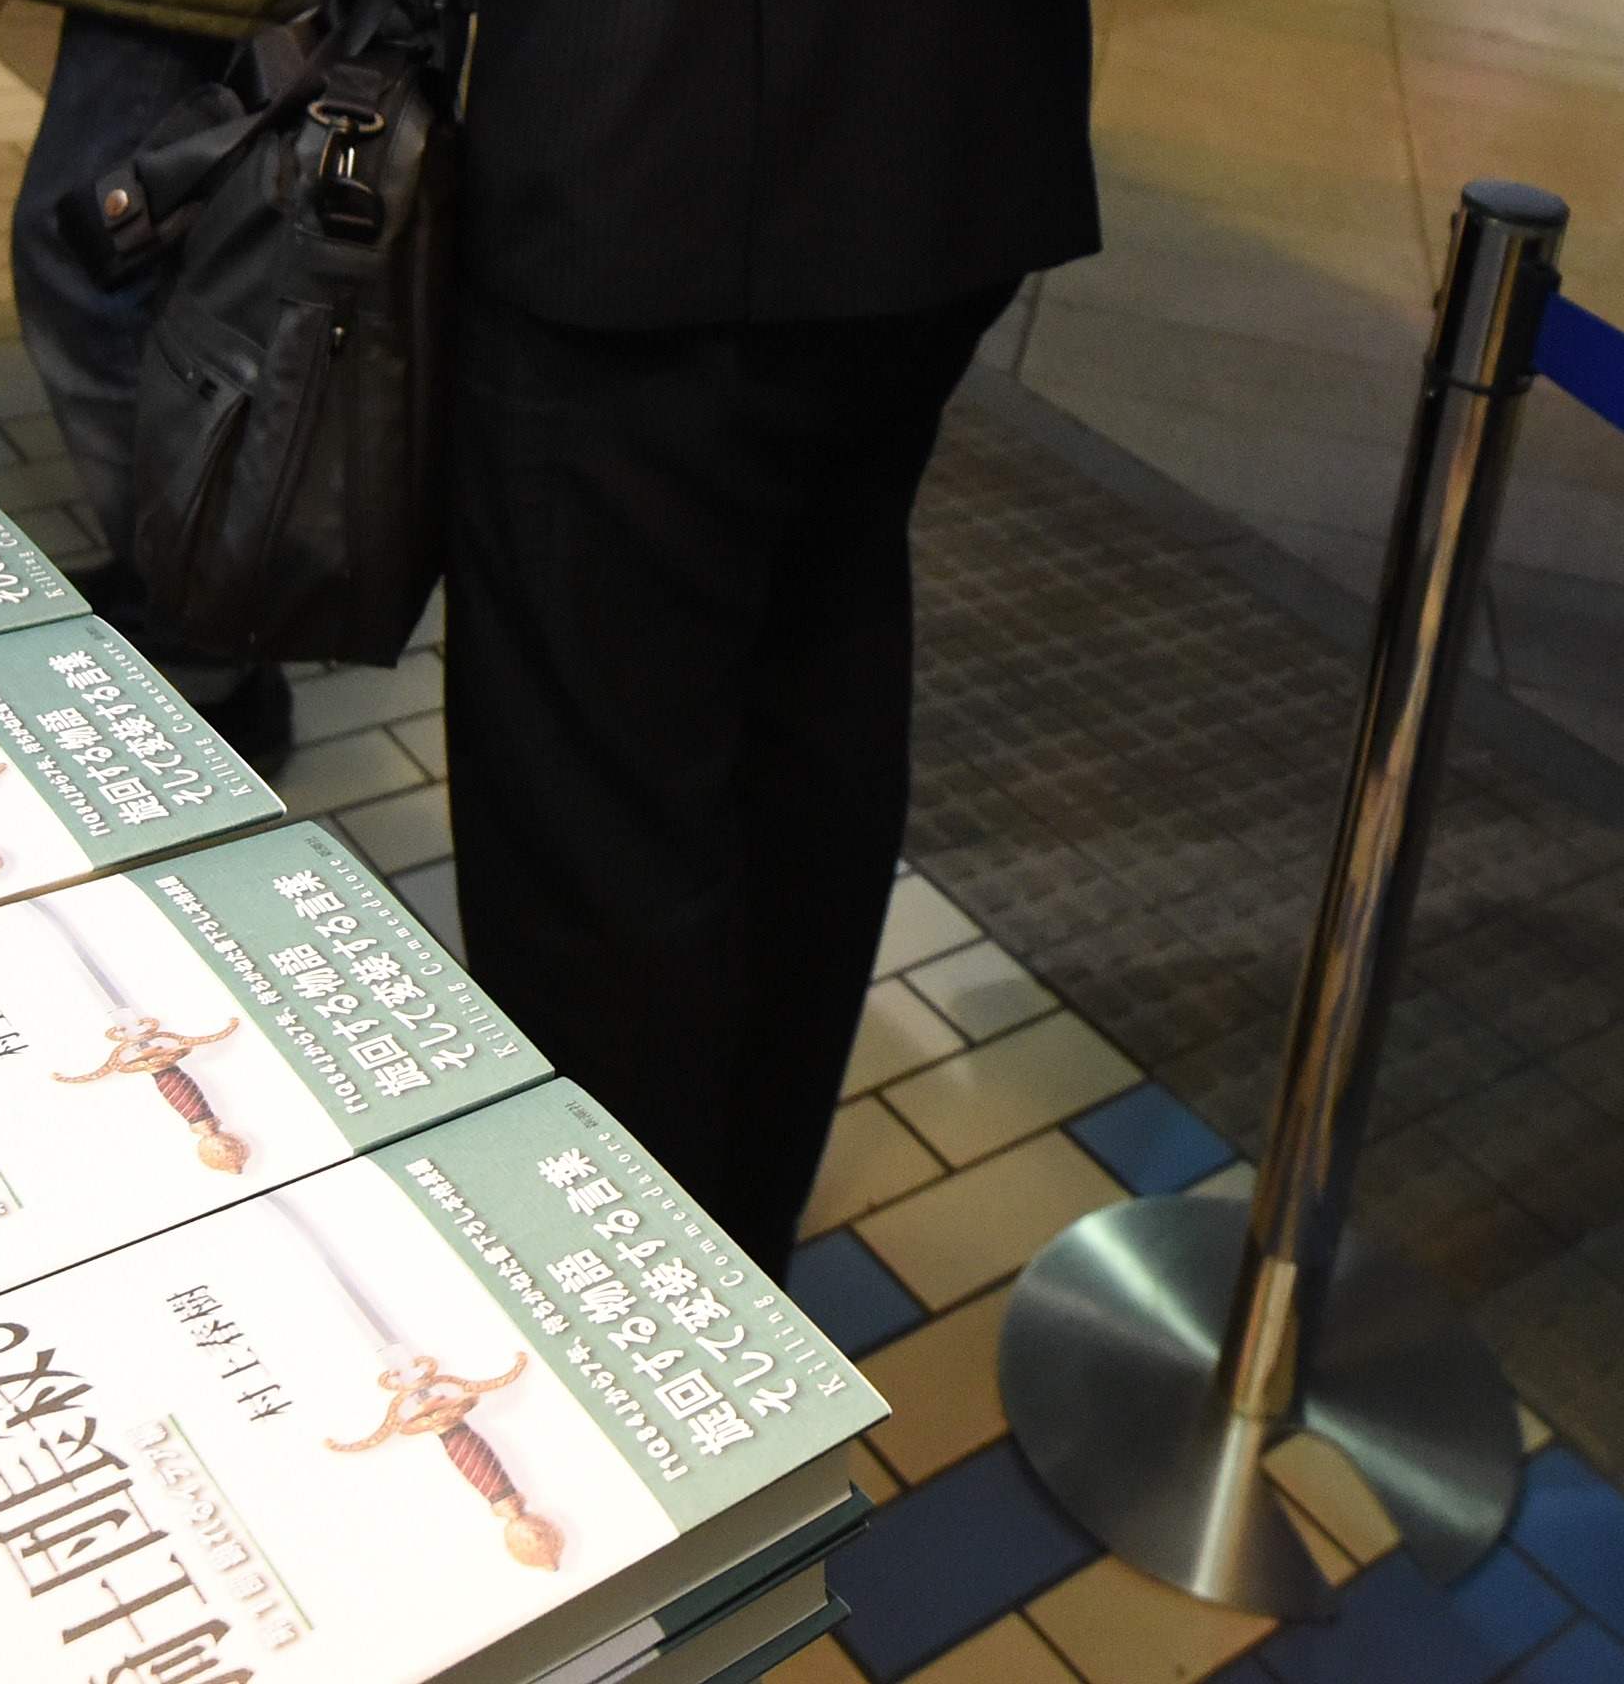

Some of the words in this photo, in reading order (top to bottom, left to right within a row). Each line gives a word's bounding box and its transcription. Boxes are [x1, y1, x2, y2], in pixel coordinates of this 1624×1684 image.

[48, 650, 212, 804] そして変装する言葉
[102, 643, 193, 732] Commendatore
[36, 706, 169, 823] 旋回する物語
[194, 738, 252, 796] Killing
[272, 869, 475, 1069] そして変装する言葉
[329, 859, 442, 974] Commendatore
[267, 942, 431, 1096] 旋回する物語
[447, 981, 519, 1057] Killing
[597, 1131, 743, 1286] Commendatore
[537, 1146, 796, 1416] そして変装する言葉
[752, 1294, 844, 1397] Killing
[165, 1284, 293, 1419] 村上春樹
[546, 1247, 753, 1455] 旋回する物語
